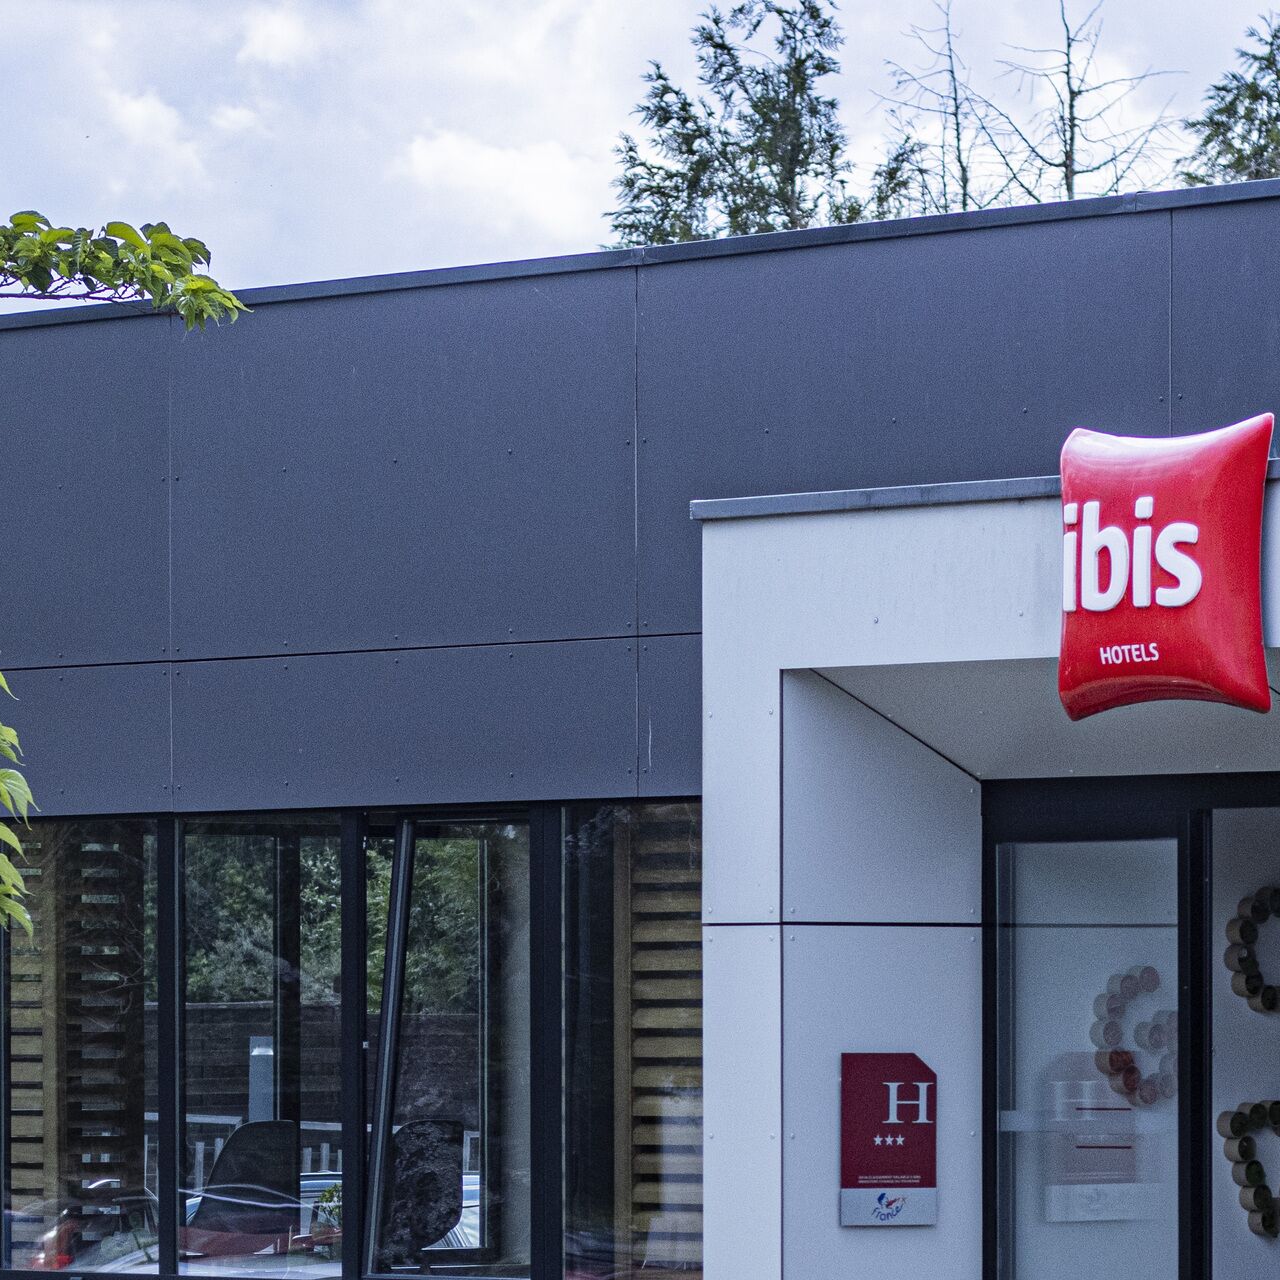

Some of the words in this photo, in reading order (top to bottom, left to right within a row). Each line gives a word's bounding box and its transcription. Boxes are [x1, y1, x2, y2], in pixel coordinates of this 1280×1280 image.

[1062, 496, 1202, 613] ibis
[1099, 642, 1160, 665] HOTELS
[882, 1081, 934, 1124] H
[871, 1204, 904, 1222] France
